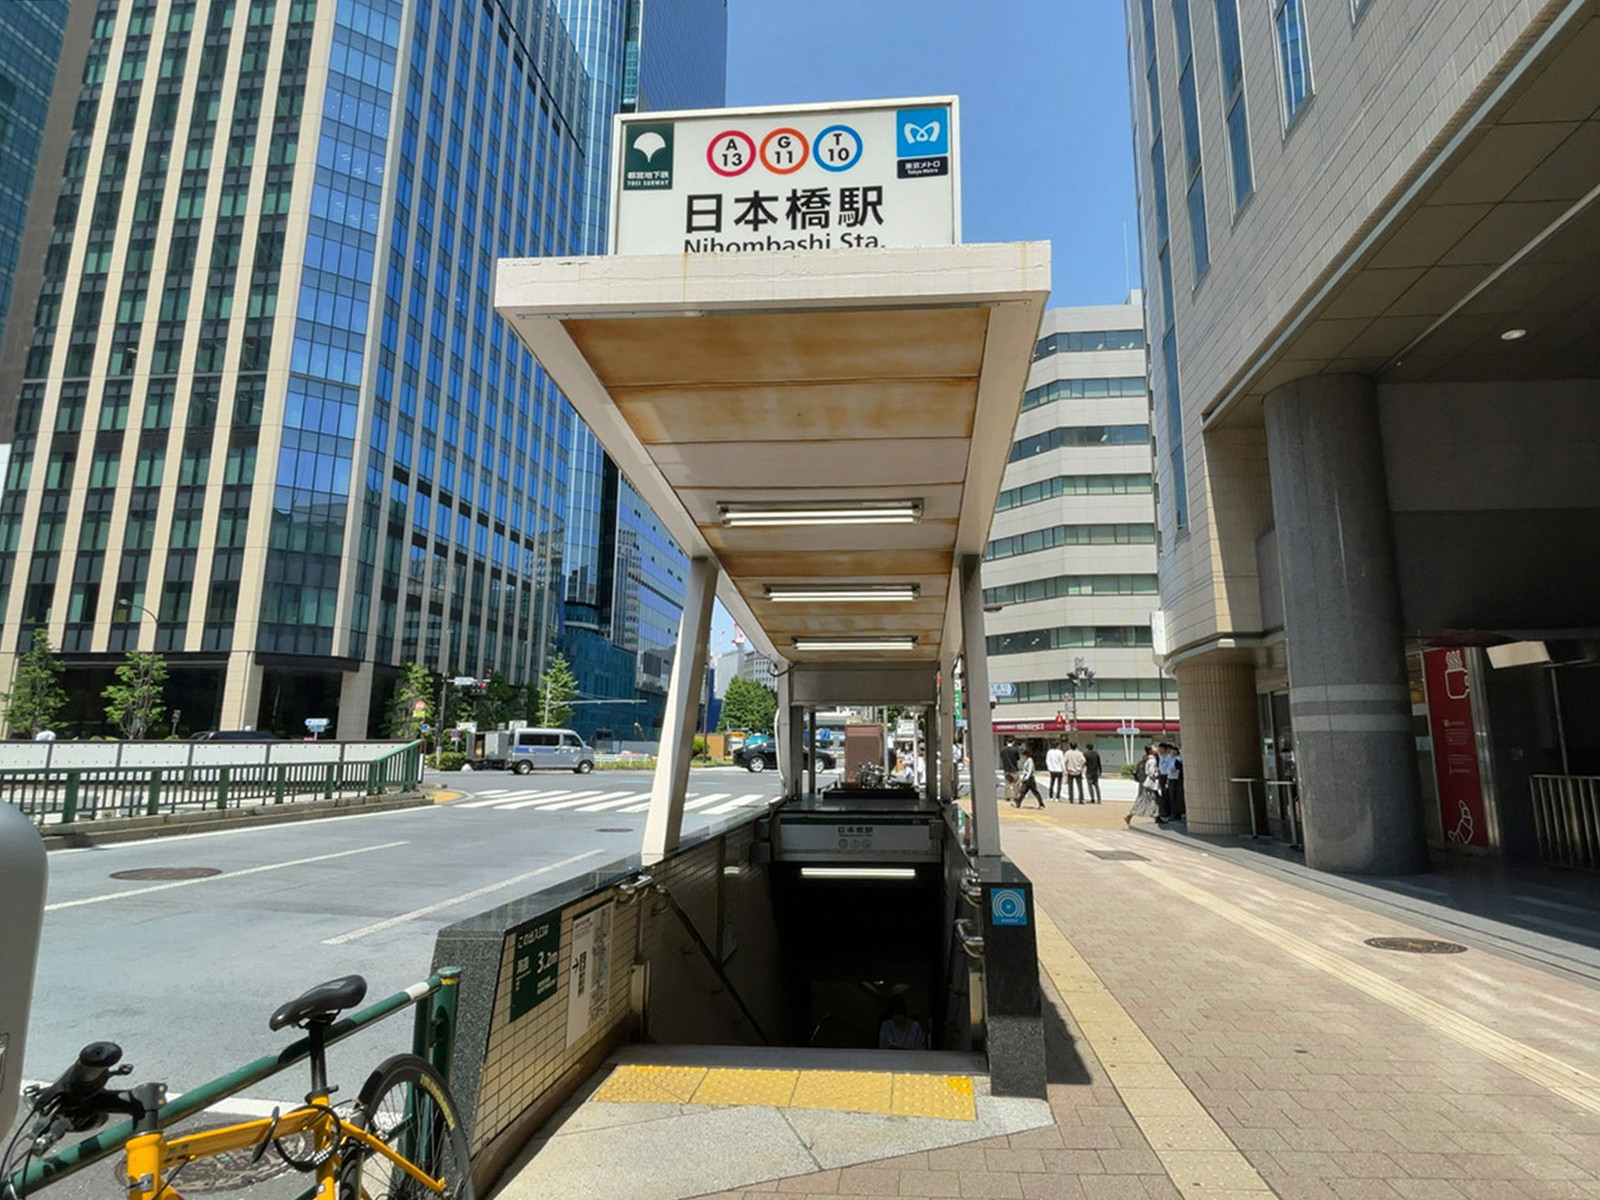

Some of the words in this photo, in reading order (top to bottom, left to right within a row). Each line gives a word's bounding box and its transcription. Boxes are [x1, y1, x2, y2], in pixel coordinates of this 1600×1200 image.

[725, 138, 738, 151] A
[777, 135, 791, 148] G
[833, 133, 843, 146] T
[722, 153, 742, 167] 13
[774, 151, 793, 164] 11
[828, 147, 849, 162] 10
[905, 160, 941, 170] 東京メトロ
[627, 171, 670, 180] 都営地下鉄
[686, 186, 885, 234] 日本橋駅
[684, 233, 831, 253] Nihombashi
[840, 232, 886, 249] Sta.
